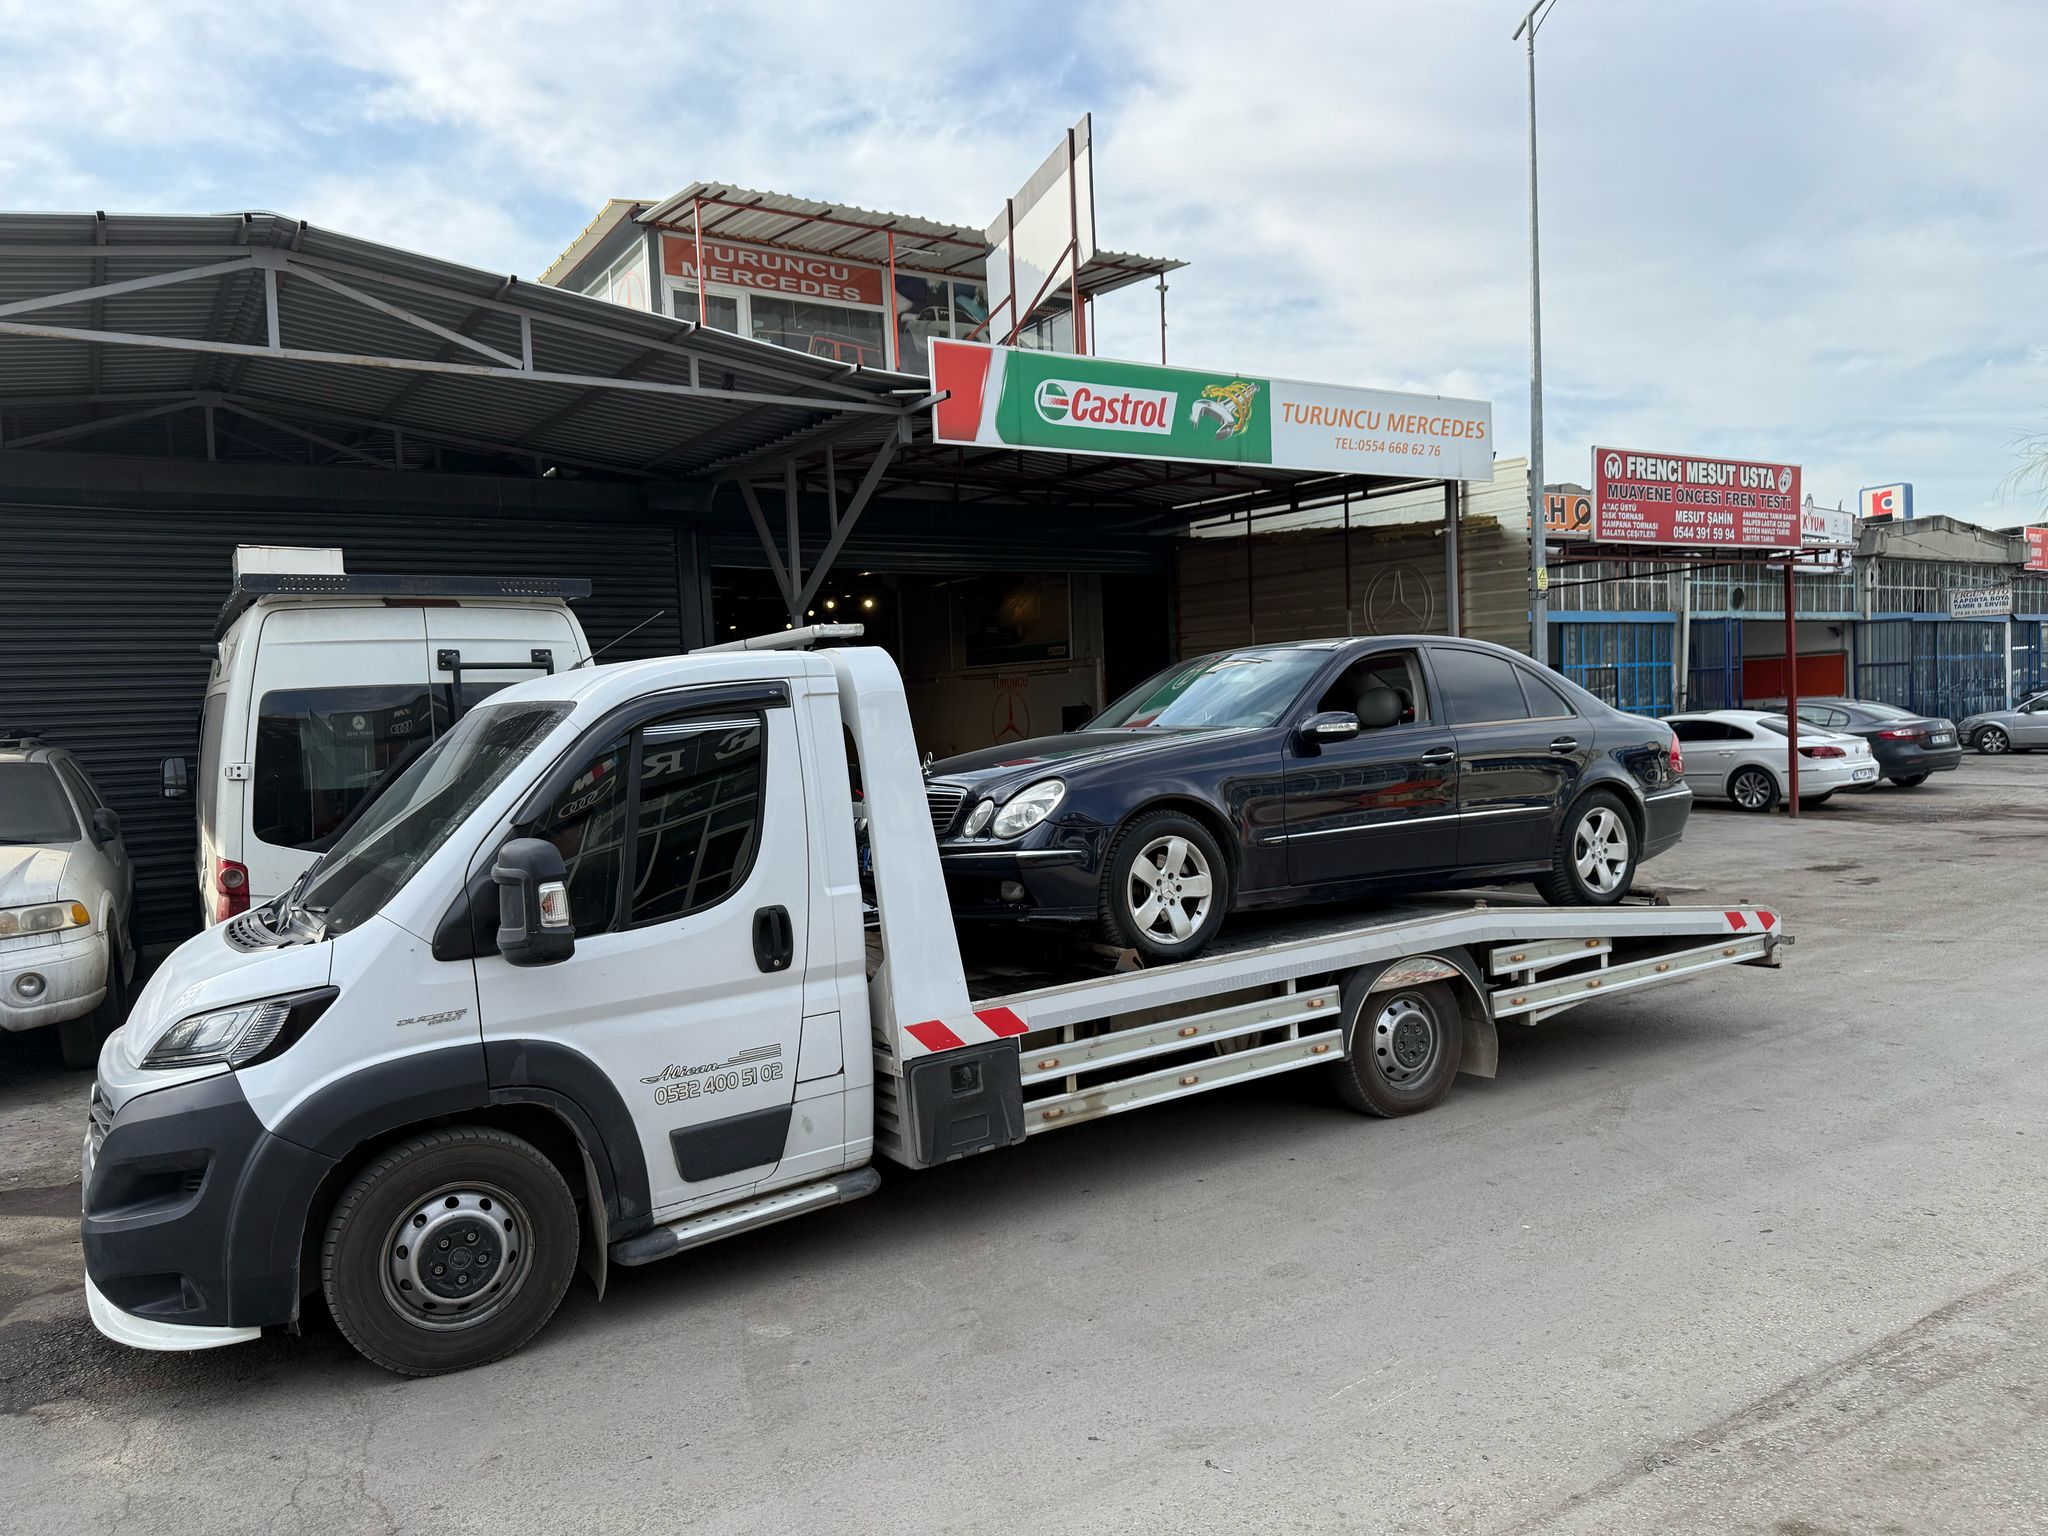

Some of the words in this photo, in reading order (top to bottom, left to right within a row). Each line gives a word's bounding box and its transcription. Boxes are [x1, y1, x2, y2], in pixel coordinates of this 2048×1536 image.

[691, 243, 849, 281] TURUNCU
[682, 261, 861, 302] MERCEDES
[1070, 387, 1168, 429] Castrol
[1282, 402, 1381, 431] TURUNCU
[1387, 412, 1485, 440] MERCEDES
[1335, 437, 1385, 453] TEL:0554
[1388, 442, 1408, 455] 668
[1411, 443, 1425, 456] 62
[1428, 444, 1441, 457] 76
[1686, 461, 1737, 486] MESUT
[1739, 465, 1776, 490] USTA
[1607, 483, 1672, 502] MUAYENE
[1725, 491, 1757, 508] FREN
[1602, 520, 1632, 528] KAMPANA
[1618, 512, 1644, 520] TORNASI
[1675, 509, 1705, 523] MESUT
[1707, 509, 1733, 527] ŞAHİN
[1602, 529, 1625, 537] BALATA
[1673, 526, 1694, 539] 0544
[1696, 527, 1711, 539] 391
[1713, 527, 1723, 539] 59
[1725, 528, 1735, 540] 94
[1990, 594, 2010, 602] BOYA
[655, 1079, 700, 1106] 0532
[703, 1072, 739, 1094] 400
[742, 1067, 758, 1087] 51
[760, 1062, 783, 1081] 02
